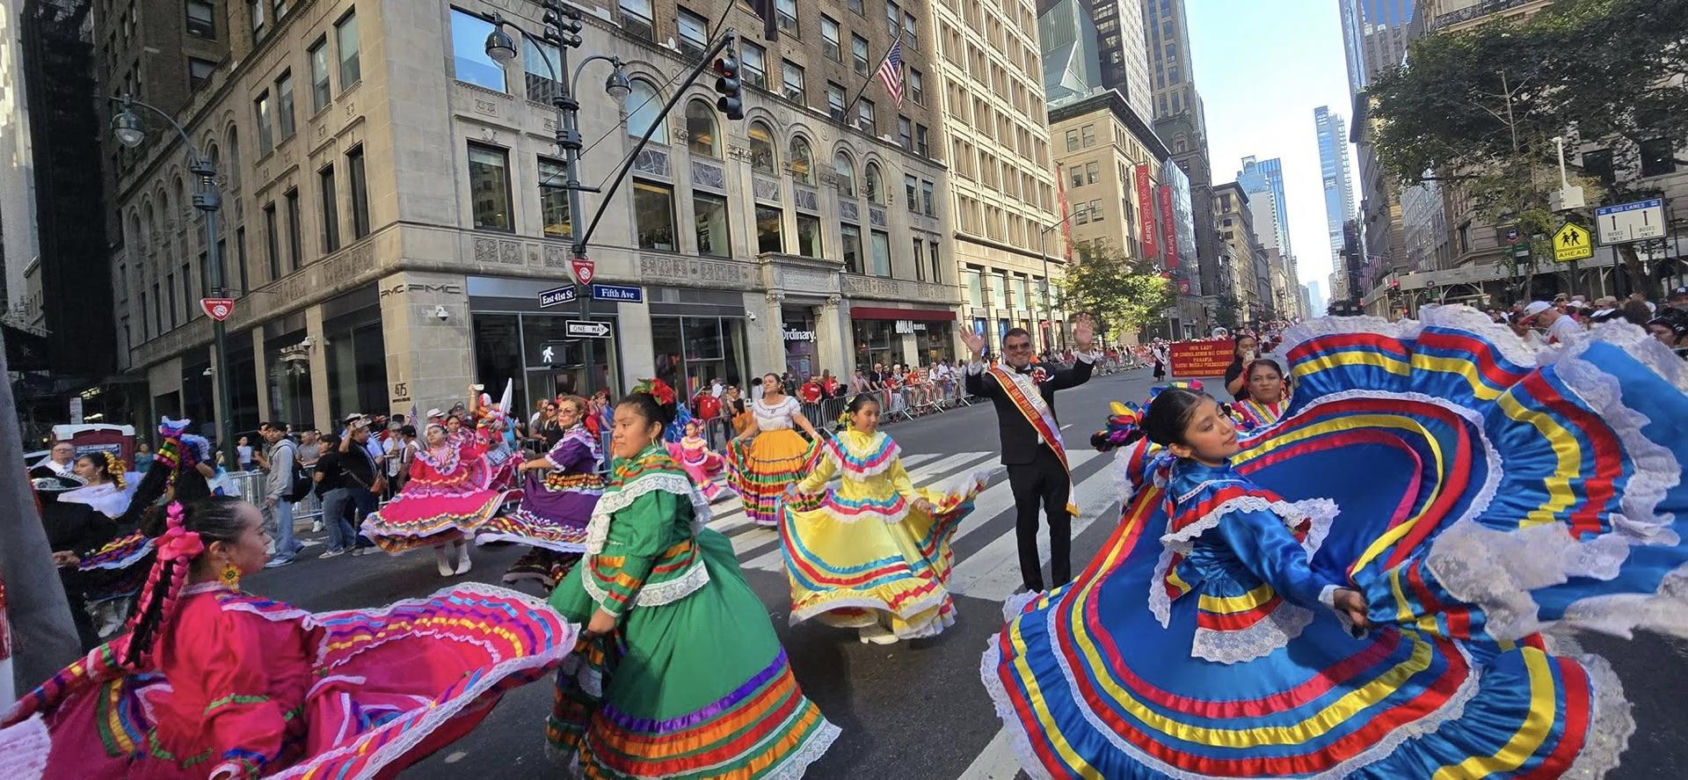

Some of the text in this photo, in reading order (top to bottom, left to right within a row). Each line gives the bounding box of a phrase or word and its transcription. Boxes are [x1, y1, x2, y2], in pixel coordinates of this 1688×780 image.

[1624, 203, 1646, 211] LANES
[1144, 221, 1153, 245] Library
[1559, 249, 1588, 258] AHEAD
[542, 290, 573, 305] East 41st St
[601, 288, 635, 299] Fifth Ave
[394, 382, 407, 397] 475
